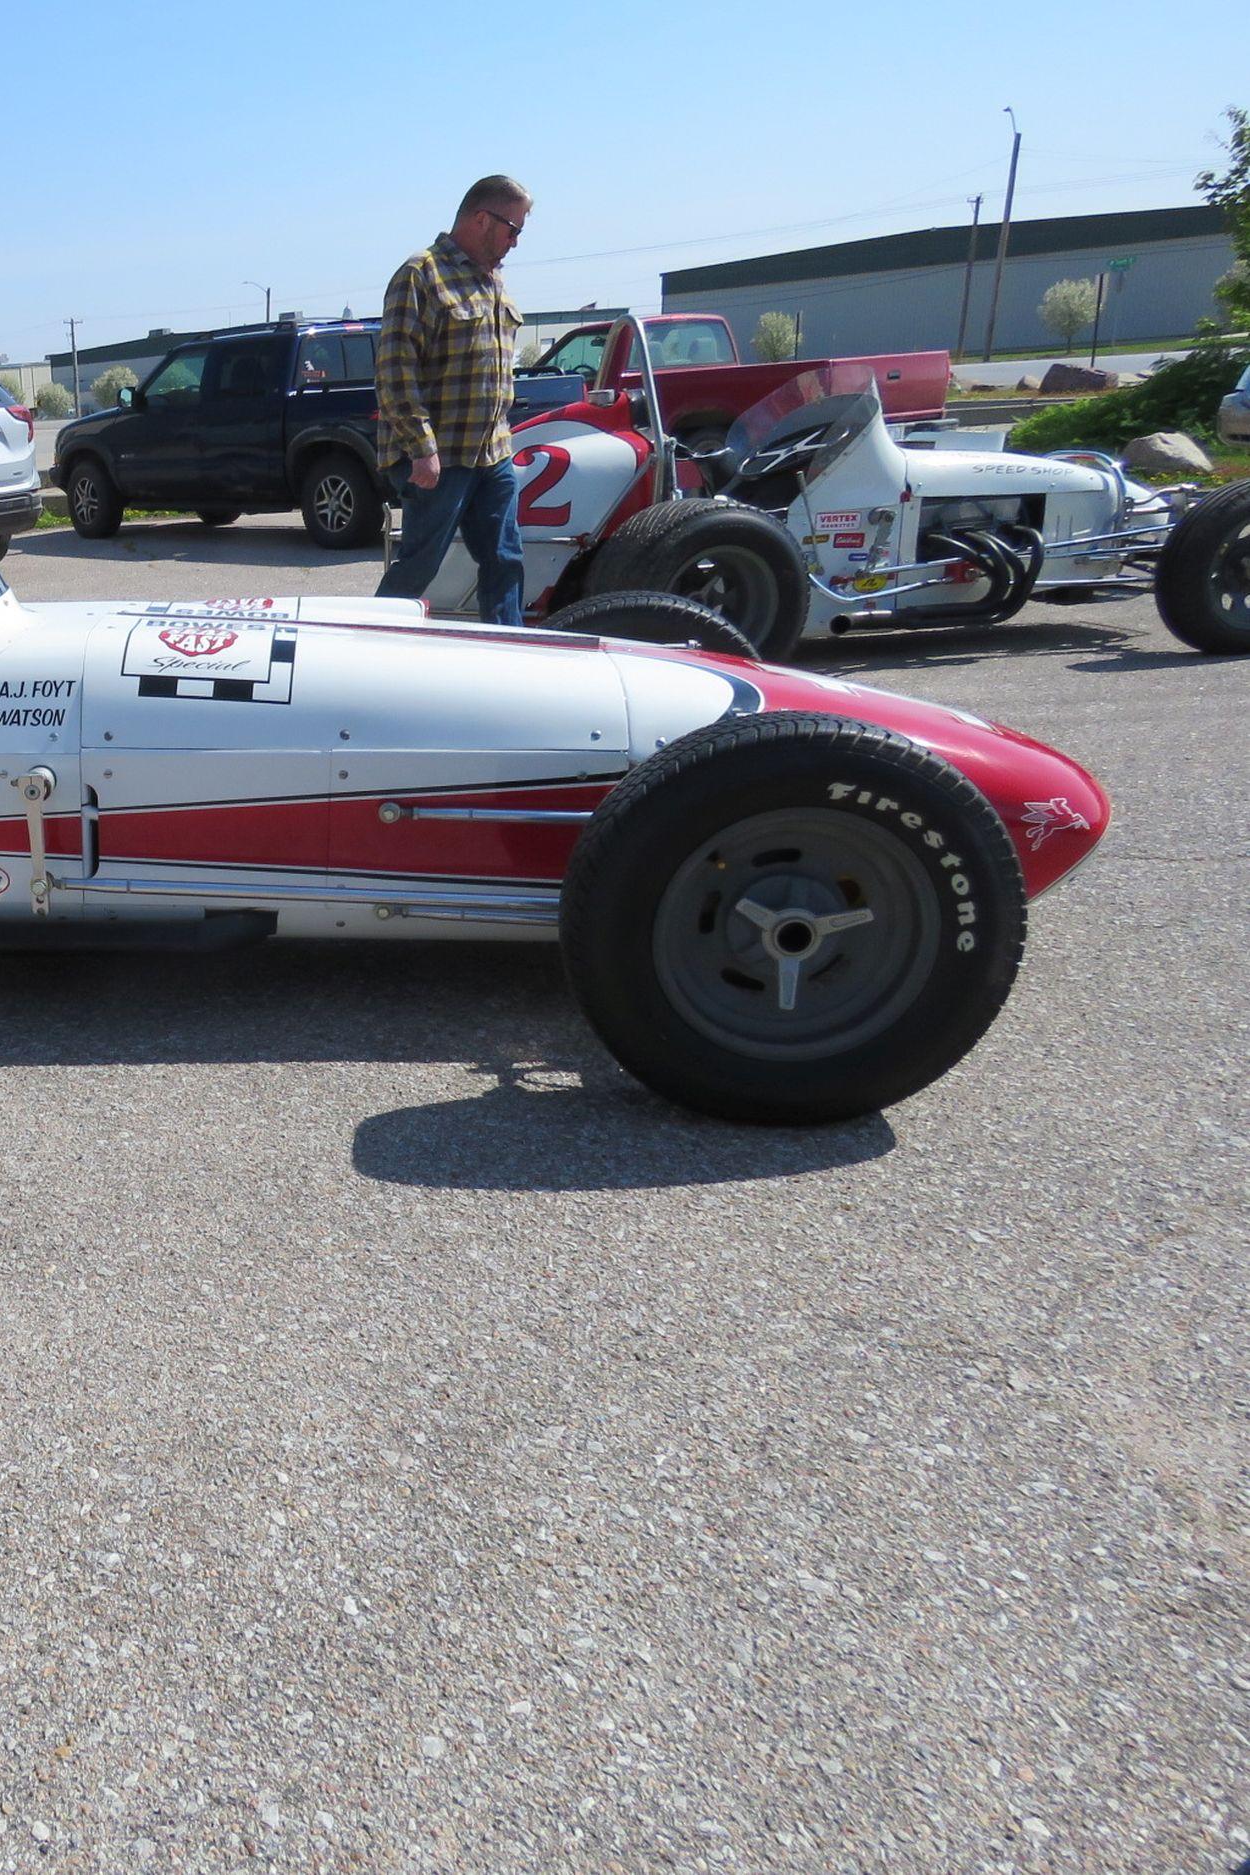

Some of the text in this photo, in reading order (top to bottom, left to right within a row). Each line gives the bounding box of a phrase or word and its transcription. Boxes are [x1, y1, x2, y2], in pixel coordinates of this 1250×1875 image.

[972, 464, 1075, 475] SPEED SHOP
[512, 444, 571, 527] 2
[820, 514, 858, 523] VERTEX
[176, 608, 289, 619] BOWES
[146, 620, 267, 630] BOWES
[167, 634, 233, 653] FAST
[146, 656, 250, 673] Special
[32, 680, 76, 698] FOYT
[827, 782, 975, 952] Firestone
